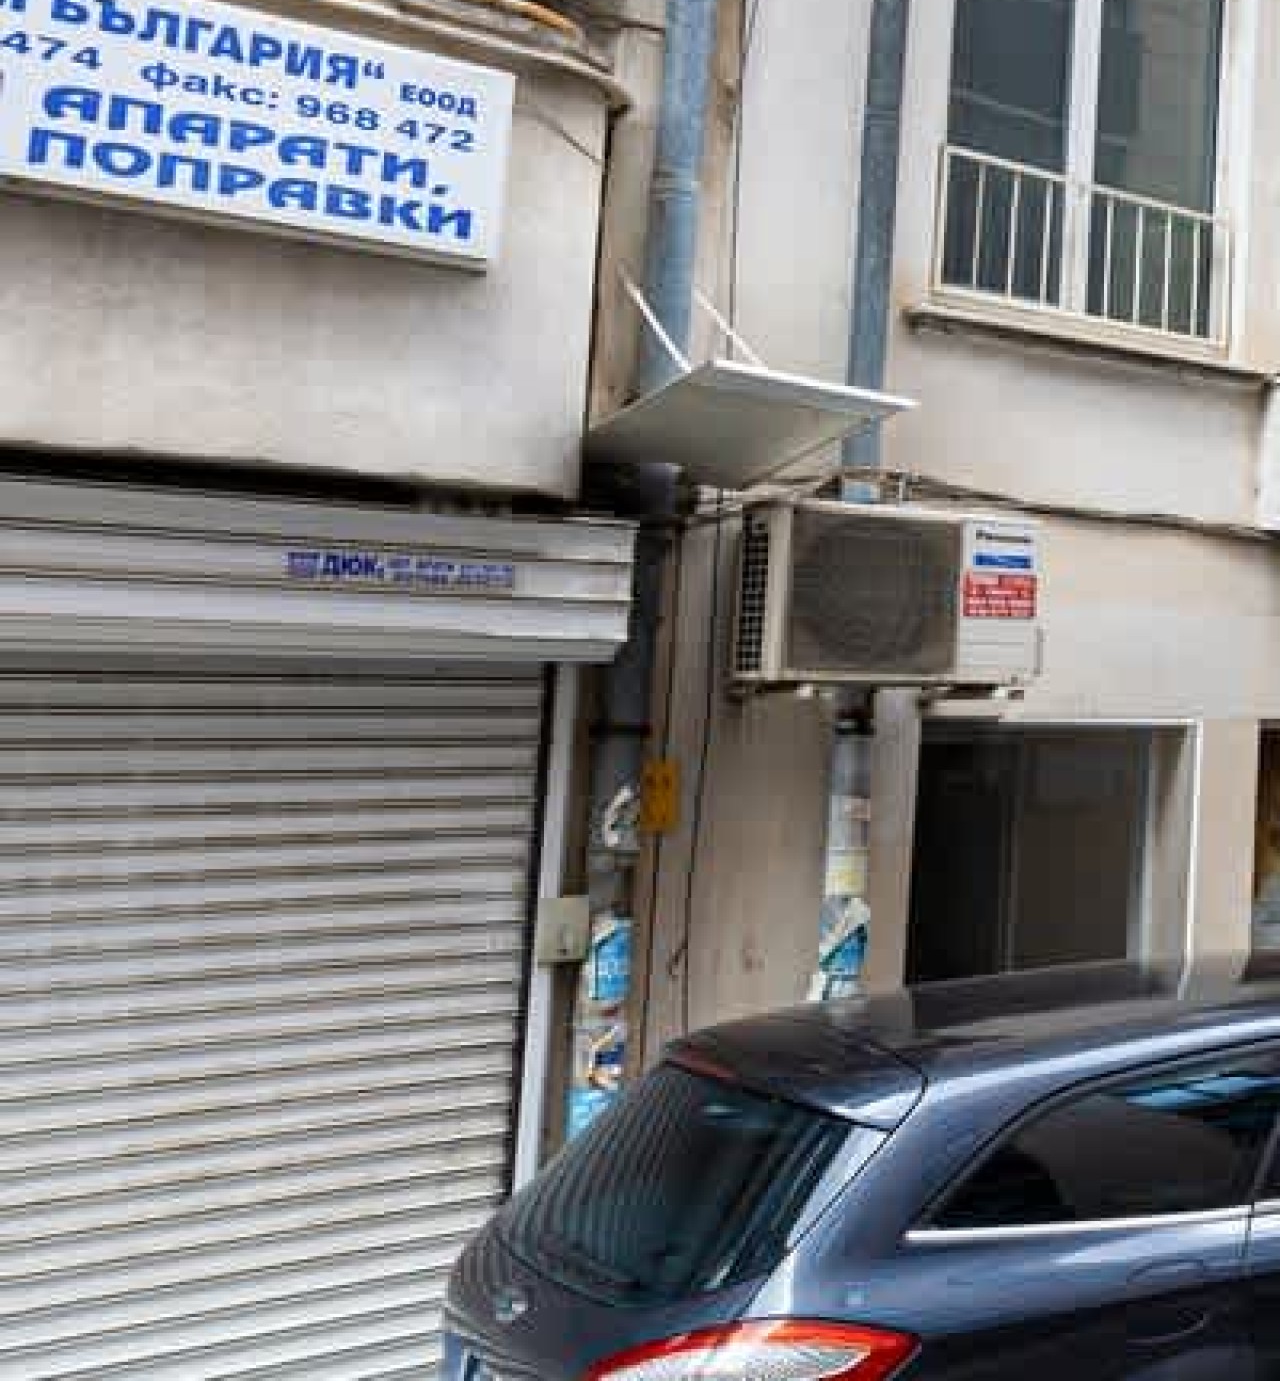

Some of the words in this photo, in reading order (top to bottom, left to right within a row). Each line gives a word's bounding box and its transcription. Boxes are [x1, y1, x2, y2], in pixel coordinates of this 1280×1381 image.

[140, 62, 279, 110] факс:
[296, 94, 379, 130] 968
[394, 119, 474, 153] 472
[28, 126, 472, 239] ПОПРАВКИ
